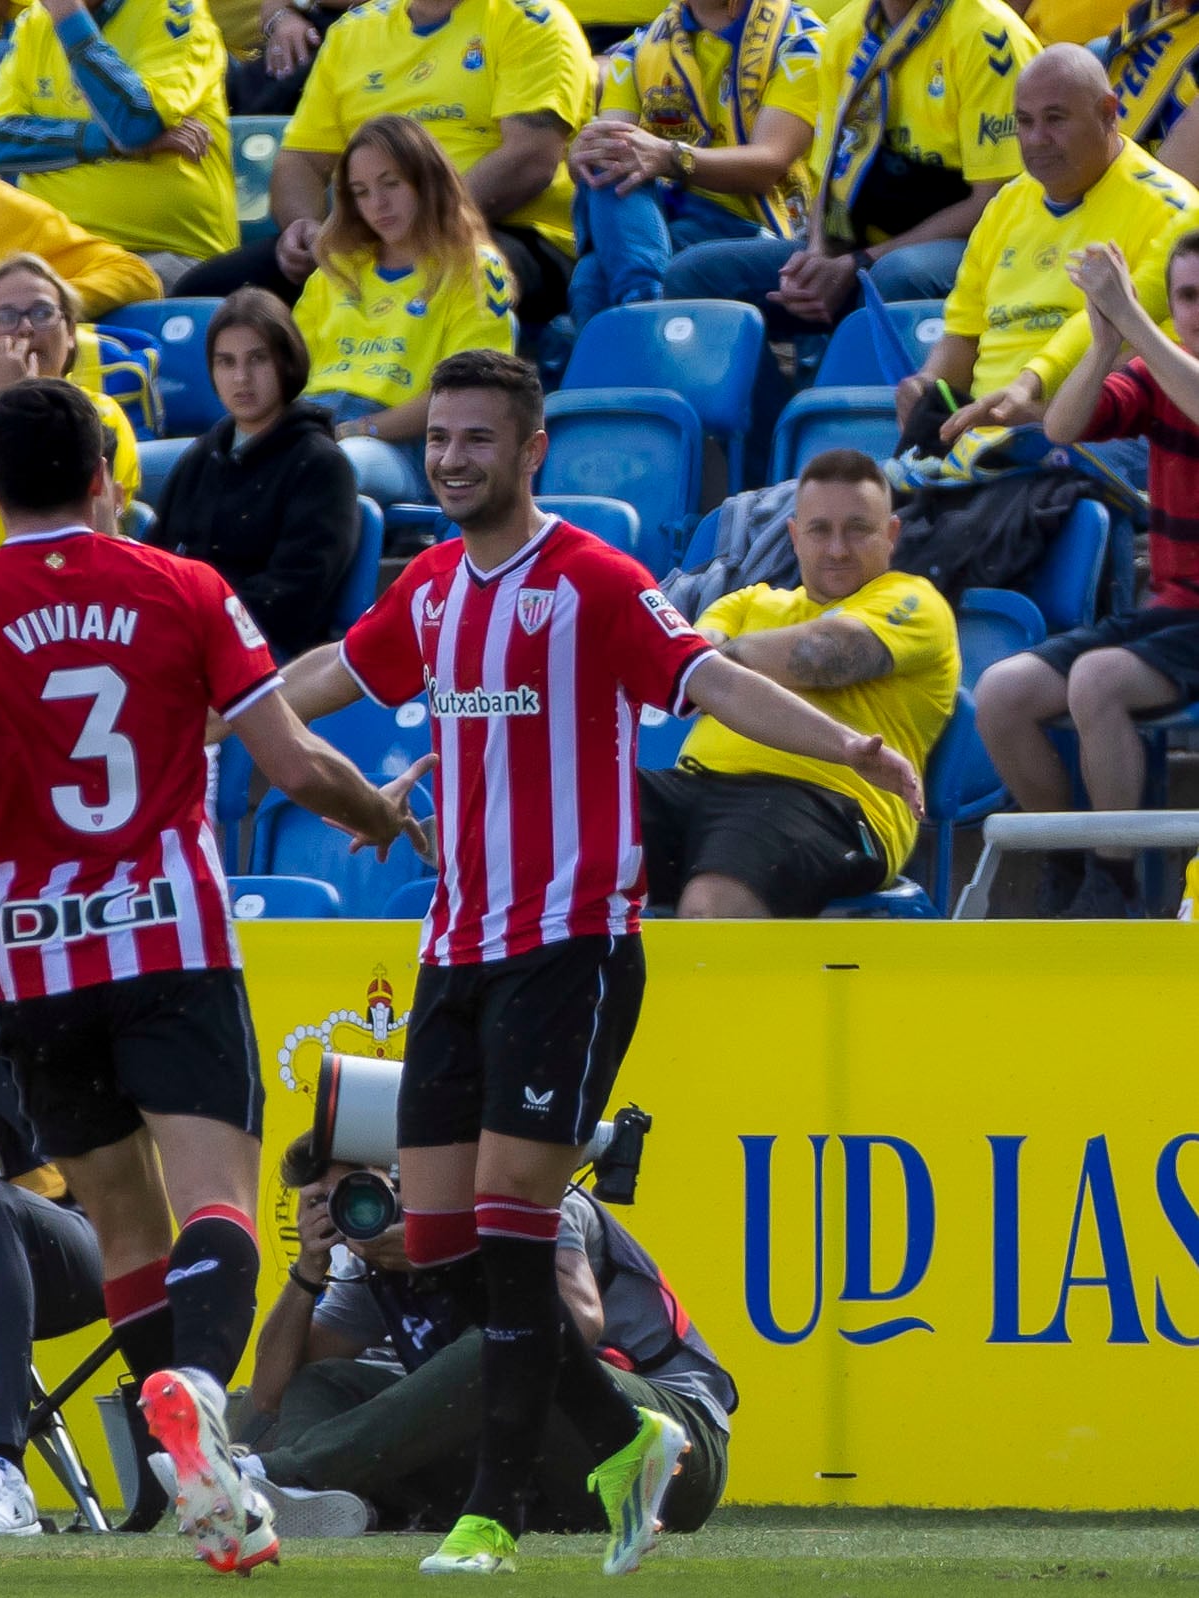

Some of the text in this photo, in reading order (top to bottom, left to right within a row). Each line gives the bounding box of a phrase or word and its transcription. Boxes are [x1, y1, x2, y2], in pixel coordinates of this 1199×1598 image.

[978, 112, 1018, 146] Kali
[2, 603, 139, 655] VIVIAN
[40, 664, 140, 834] 3
[1, 879, 179, 947] DIGI
[738, 1134, 936, 1346] UD
